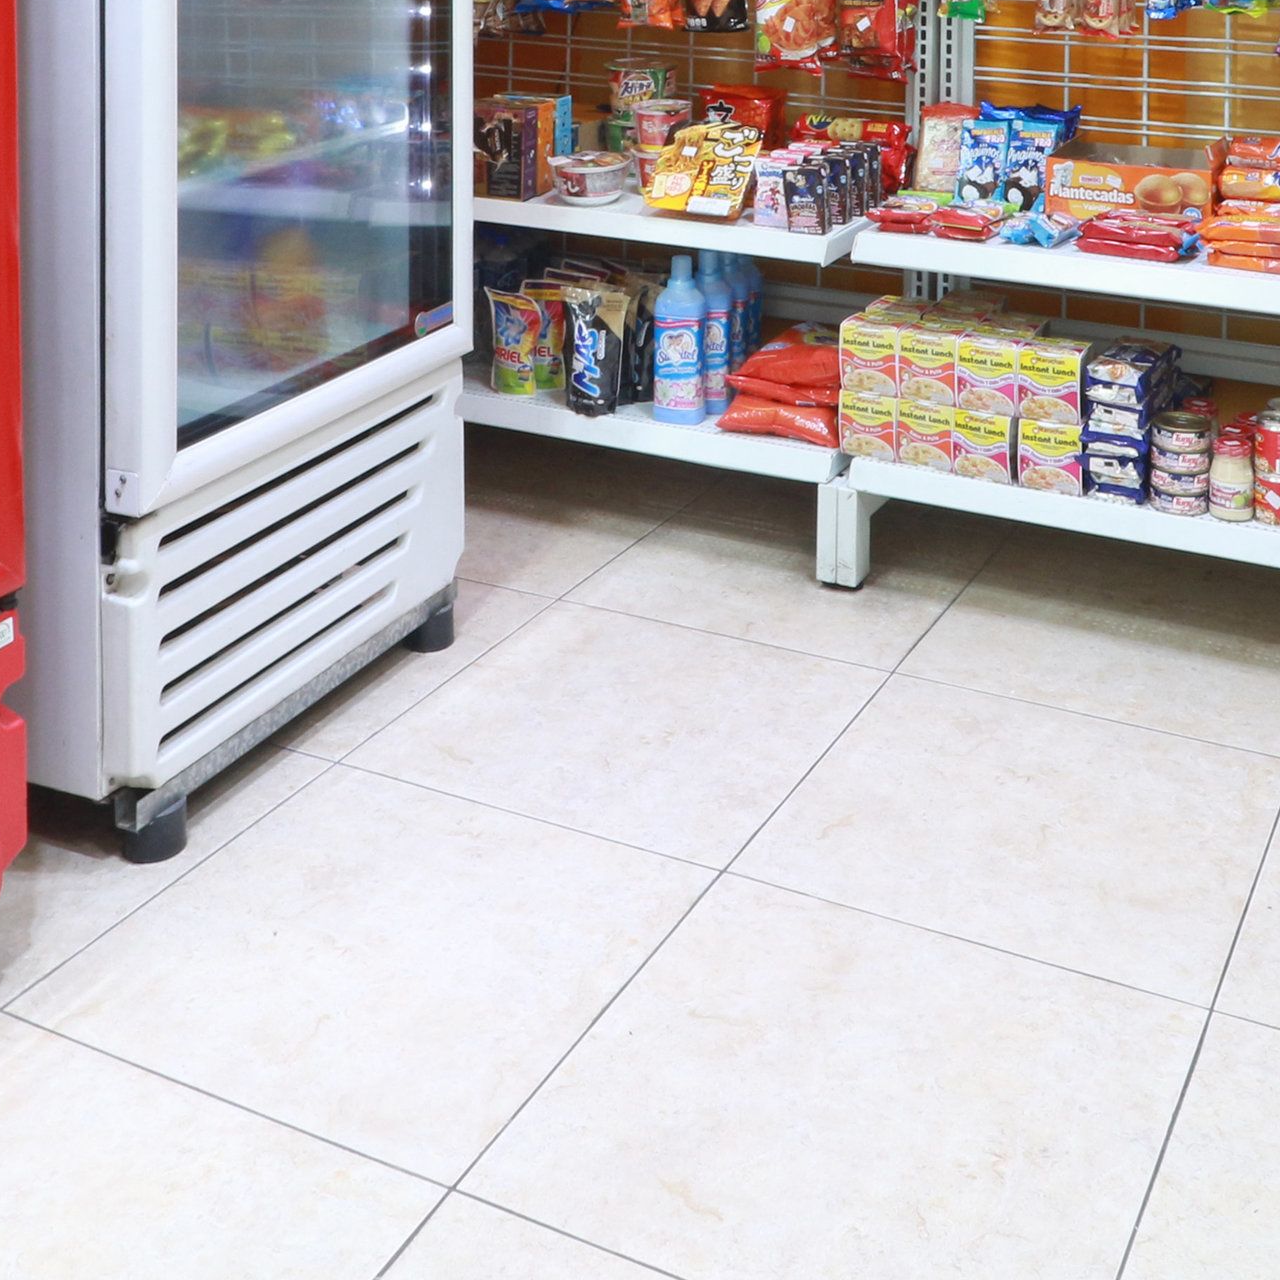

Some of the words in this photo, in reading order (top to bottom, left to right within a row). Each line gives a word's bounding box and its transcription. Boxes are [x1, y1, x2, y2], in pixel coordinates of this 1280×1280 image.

[1049, 183, 1135, 205] Mantecadas
[843, 337, 870, 348] Instant
[871, 340, 894, 351] Lunch
[901, 345, 929, 356] Instant
[931, 349, 954, 359] Lunch
[959, 355, 988, 366] Instant
[989, 359, 1013, 370] Lunch
[1020, 363, 1050, 374] Instant
[1052, 367, 1076, 377] Lunch
[842, 402, 869, 413] Instant
[870, 406, 893, 417] Lunch
[899, 410, 927, 421] Instant
[928, 415, 951, 426] Lunch
[955, 421, 982, 432] Instant
[983, 426, 1006, 438] Lunch
[1022, 433, 1052, 444] Instant
[1053, 438, 1078, 448] Lunch
